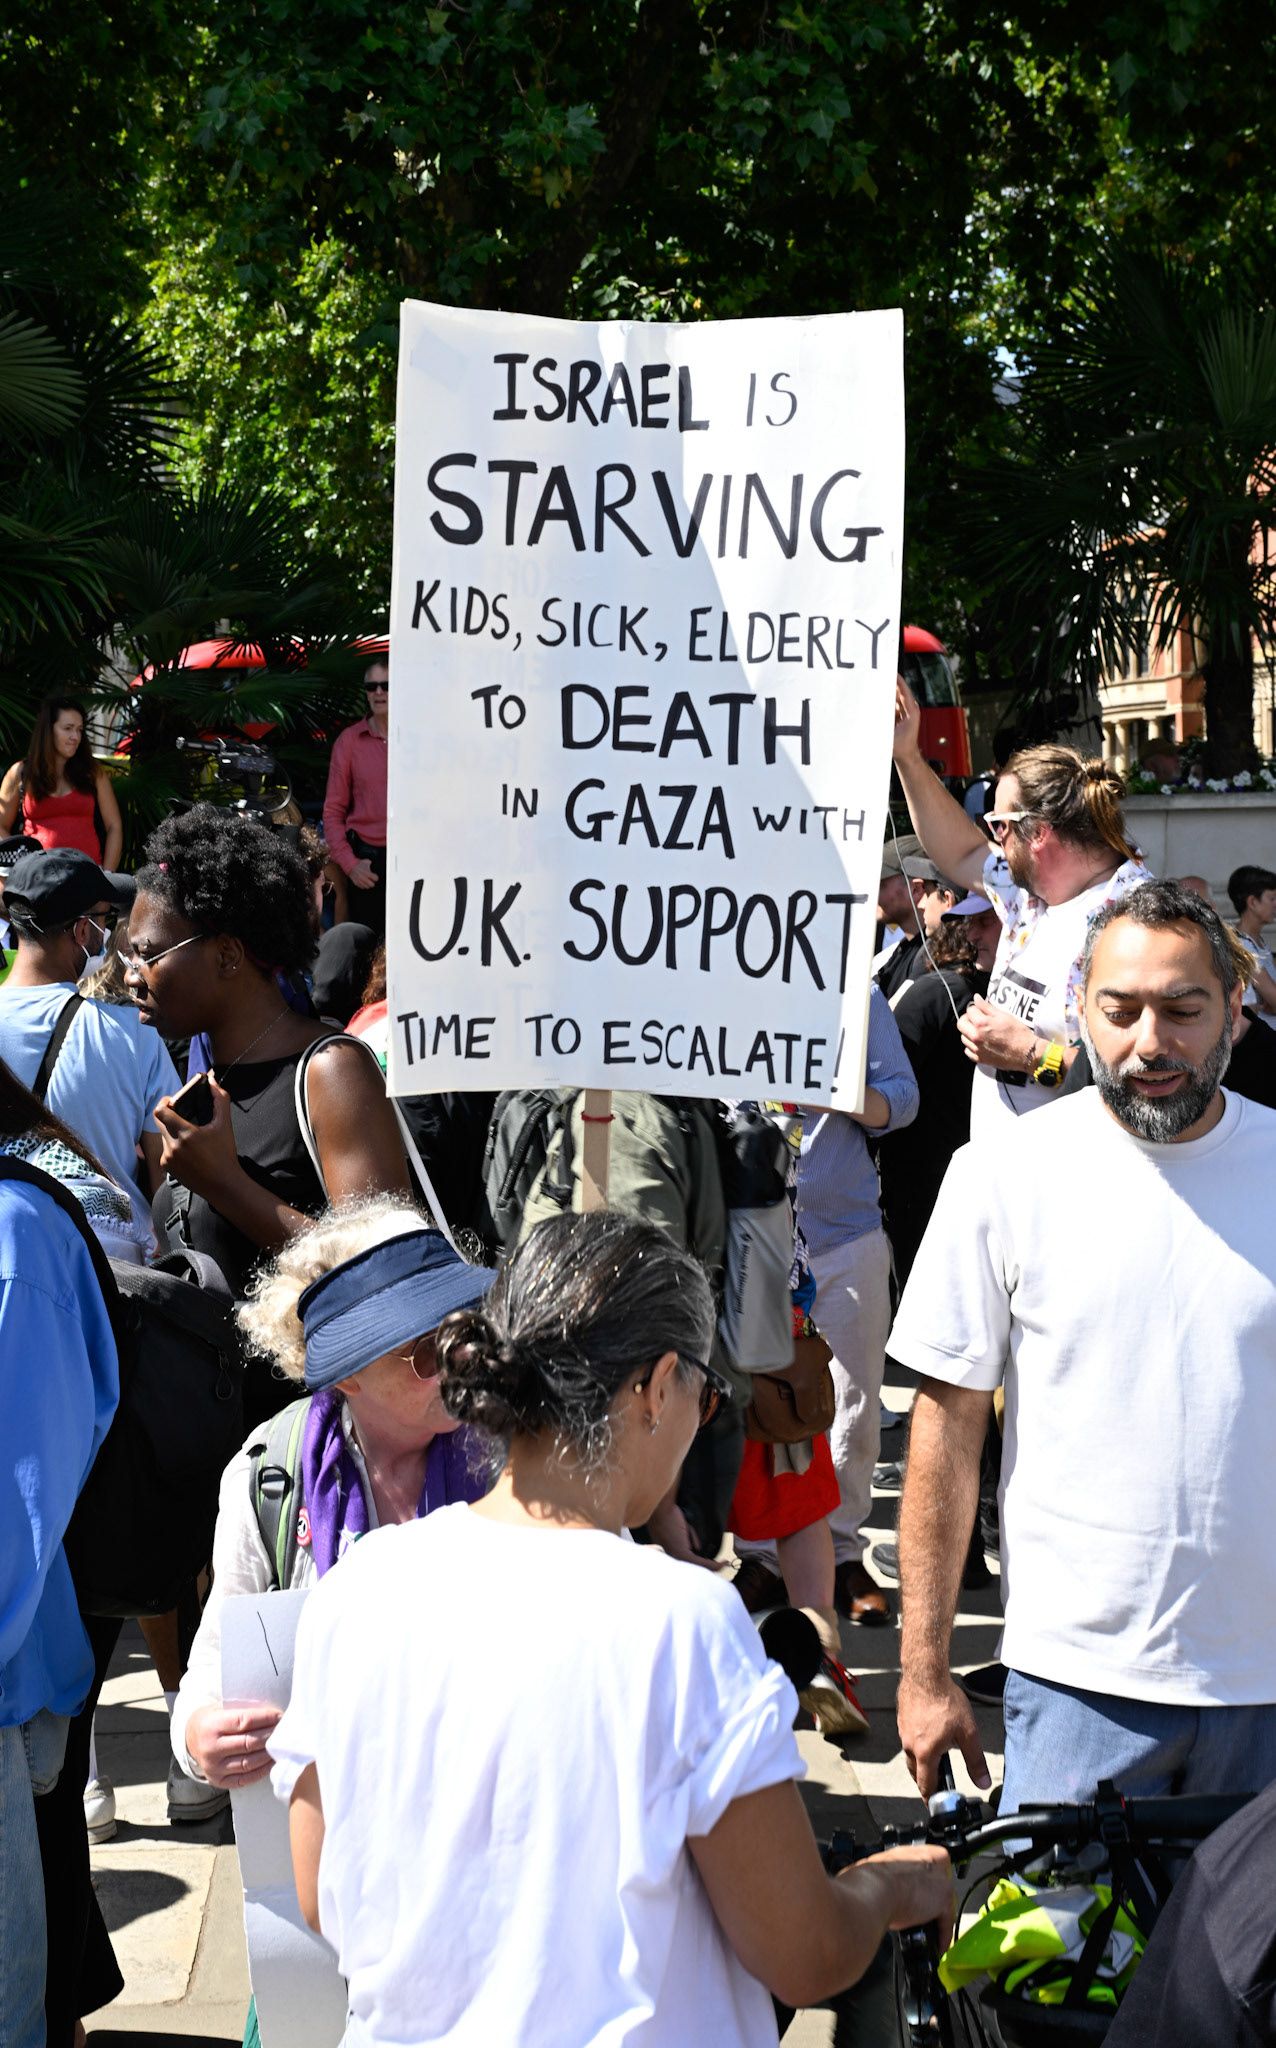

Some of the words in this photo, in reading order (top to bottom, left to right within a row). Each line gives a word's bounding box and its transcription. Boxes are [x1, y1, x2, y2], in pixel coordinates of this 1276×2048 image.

[493, 353, 709, 433] ISRAEL
[747, 373, 797, 426] IS
[427, 453, 884, 562] STARVING
[411, 580, 521, 651] KIDS,
[537, 597, 668, 662] SICK,
[689, 606, 890, 669] ELDERLY
[471, 684, 526, 729] TO
[561, 684, 810, 766] DEATH
[502, 784, 538, 818] IN
[565, 778, 735, 860] GAZA
[752, 806, 865, 840] WITH
[409, 877, 531, 967] U.K.
[563, 879, 868, 994] SUPPORT
[397, 1011, 496, 1065] TIME
[525, 1013, 581, 1057] TO
[602, 1020, 845, 1093] ESCALATE!
